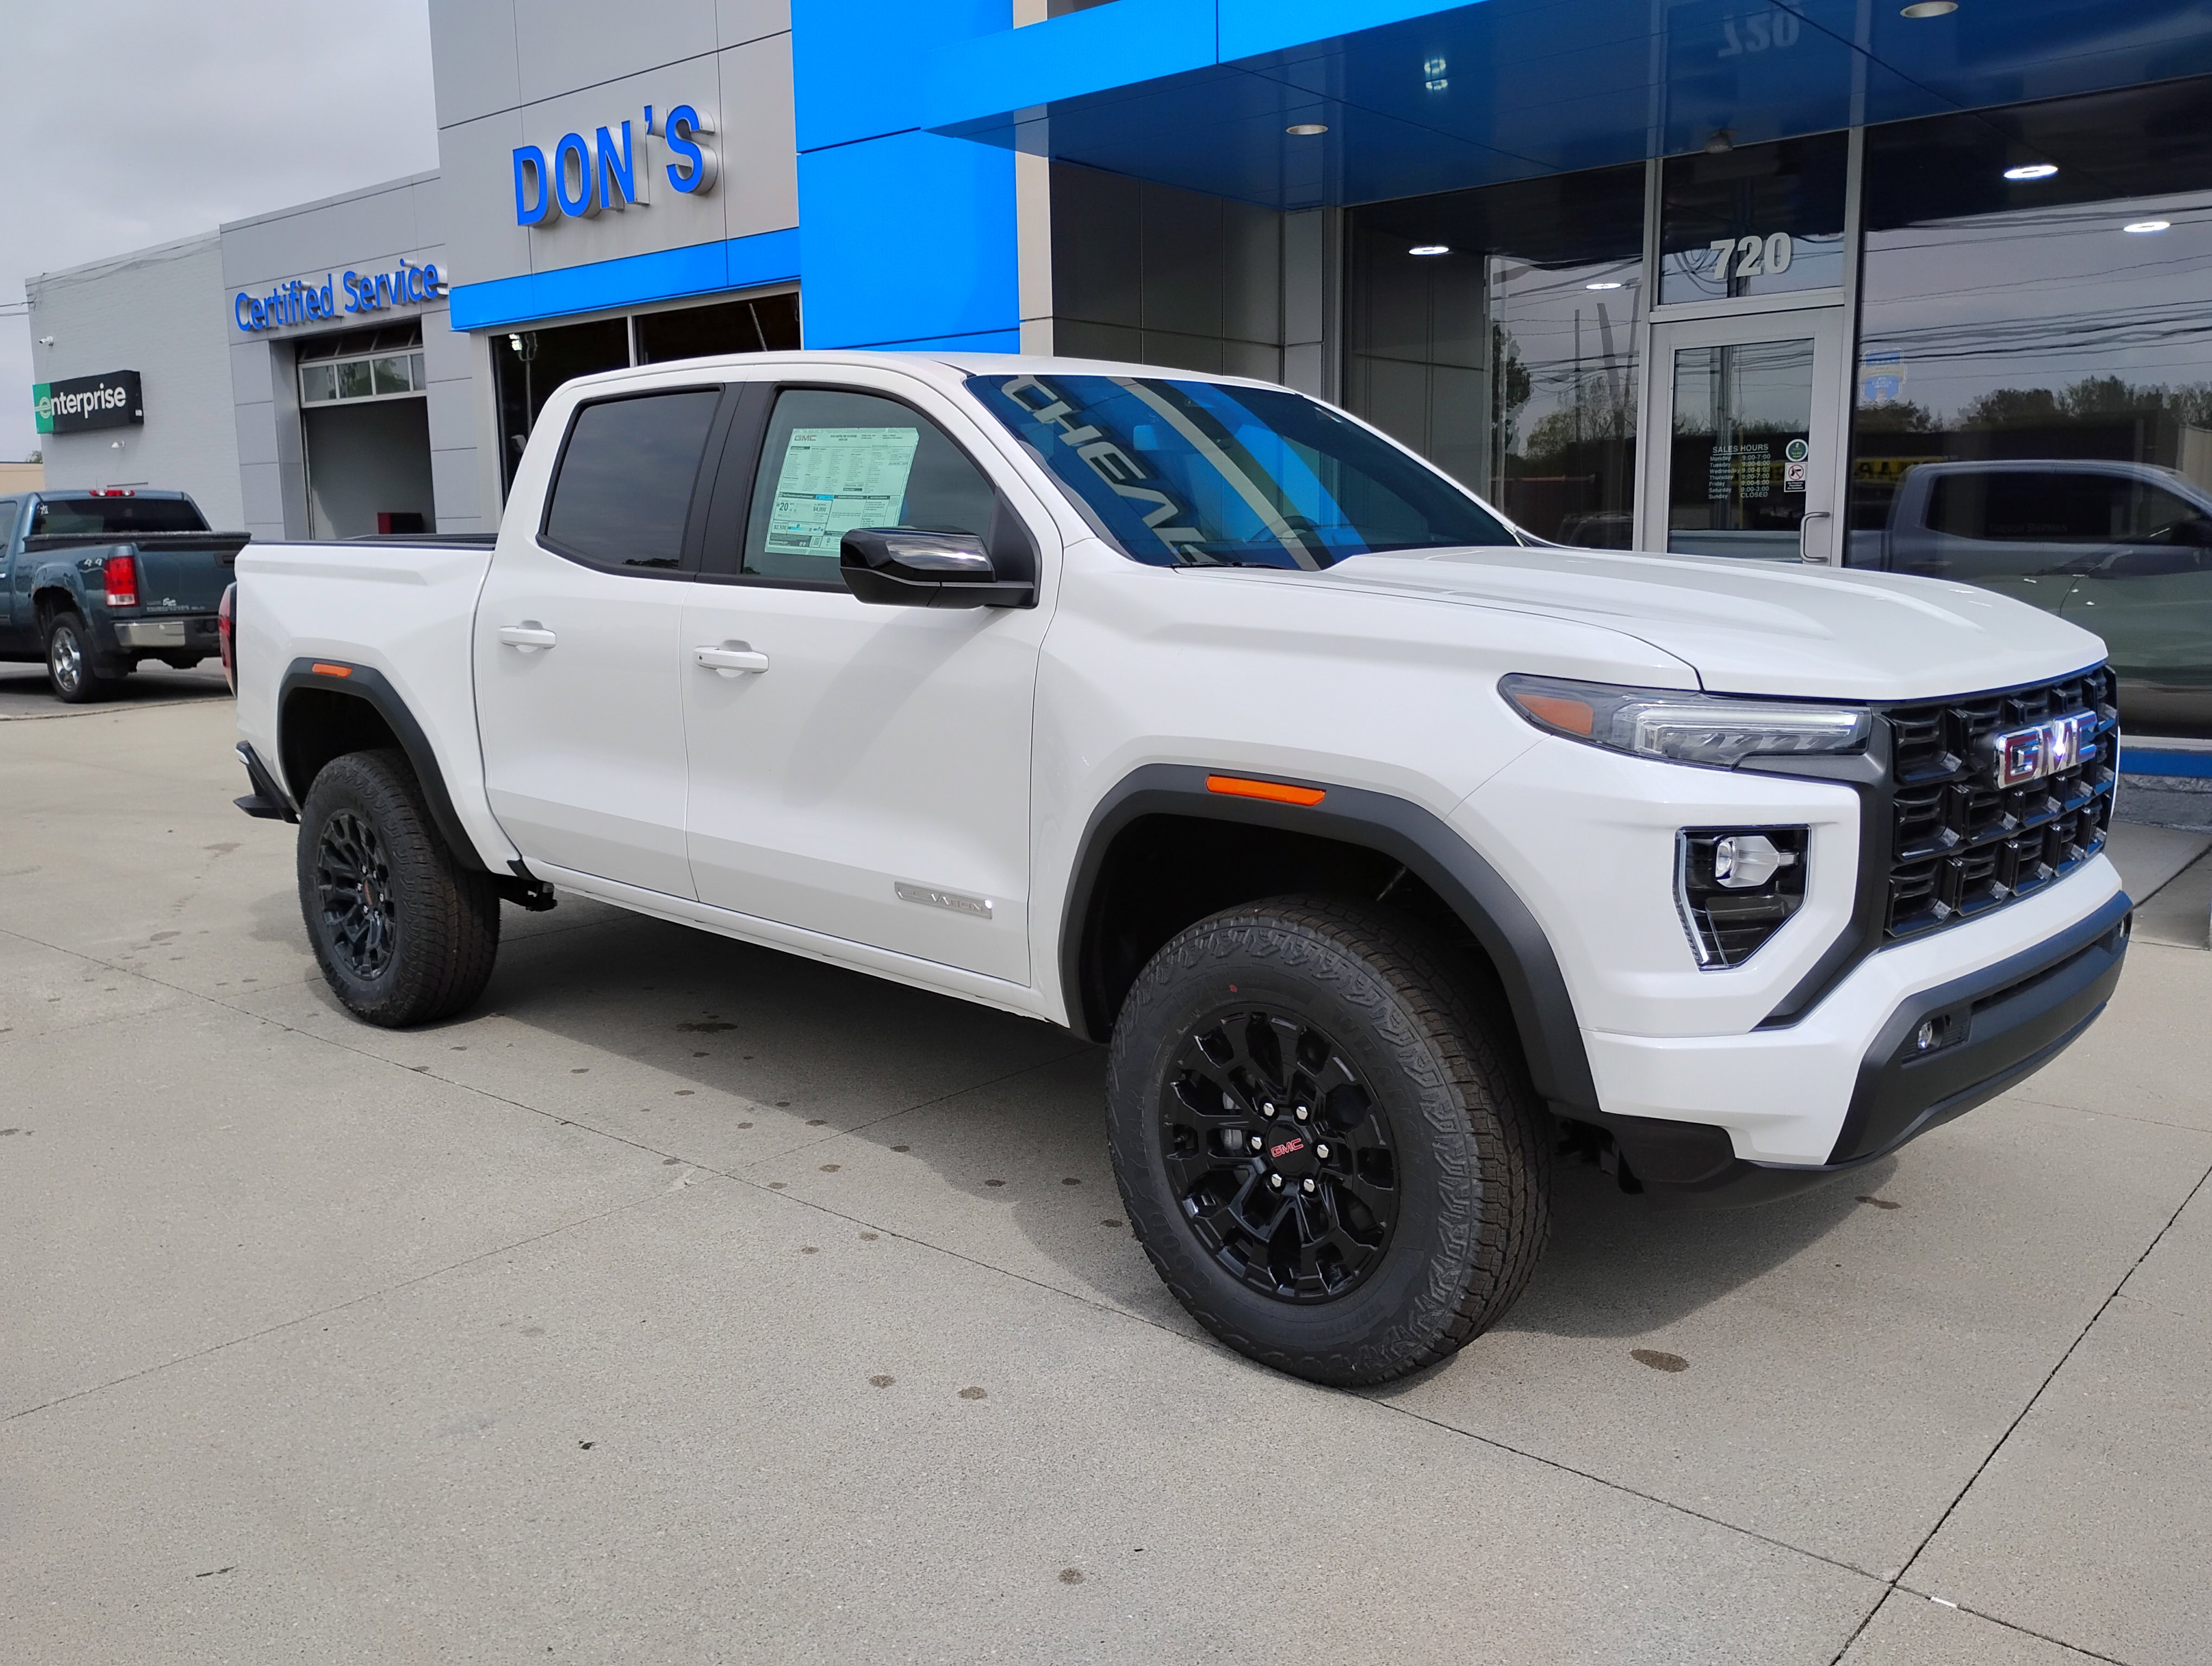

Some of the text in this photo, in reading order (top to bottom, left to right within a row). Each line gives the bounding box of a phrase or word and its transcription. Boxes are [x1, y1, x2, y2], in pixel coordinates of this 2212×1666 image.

[512, 104, 711, 227] DON'S
[1711, 232, 1791, 279] 720
[235, 258, 442, 332] Certified Service
[35, 382, 126, 419] enterprise
[1713, 444, 1769, 453] SALES HOURS
[779, 502, 789, 511] 20
[1994, 710, 2098, 789] GMC
[1270, 1138, 1304, 1158] GMC
